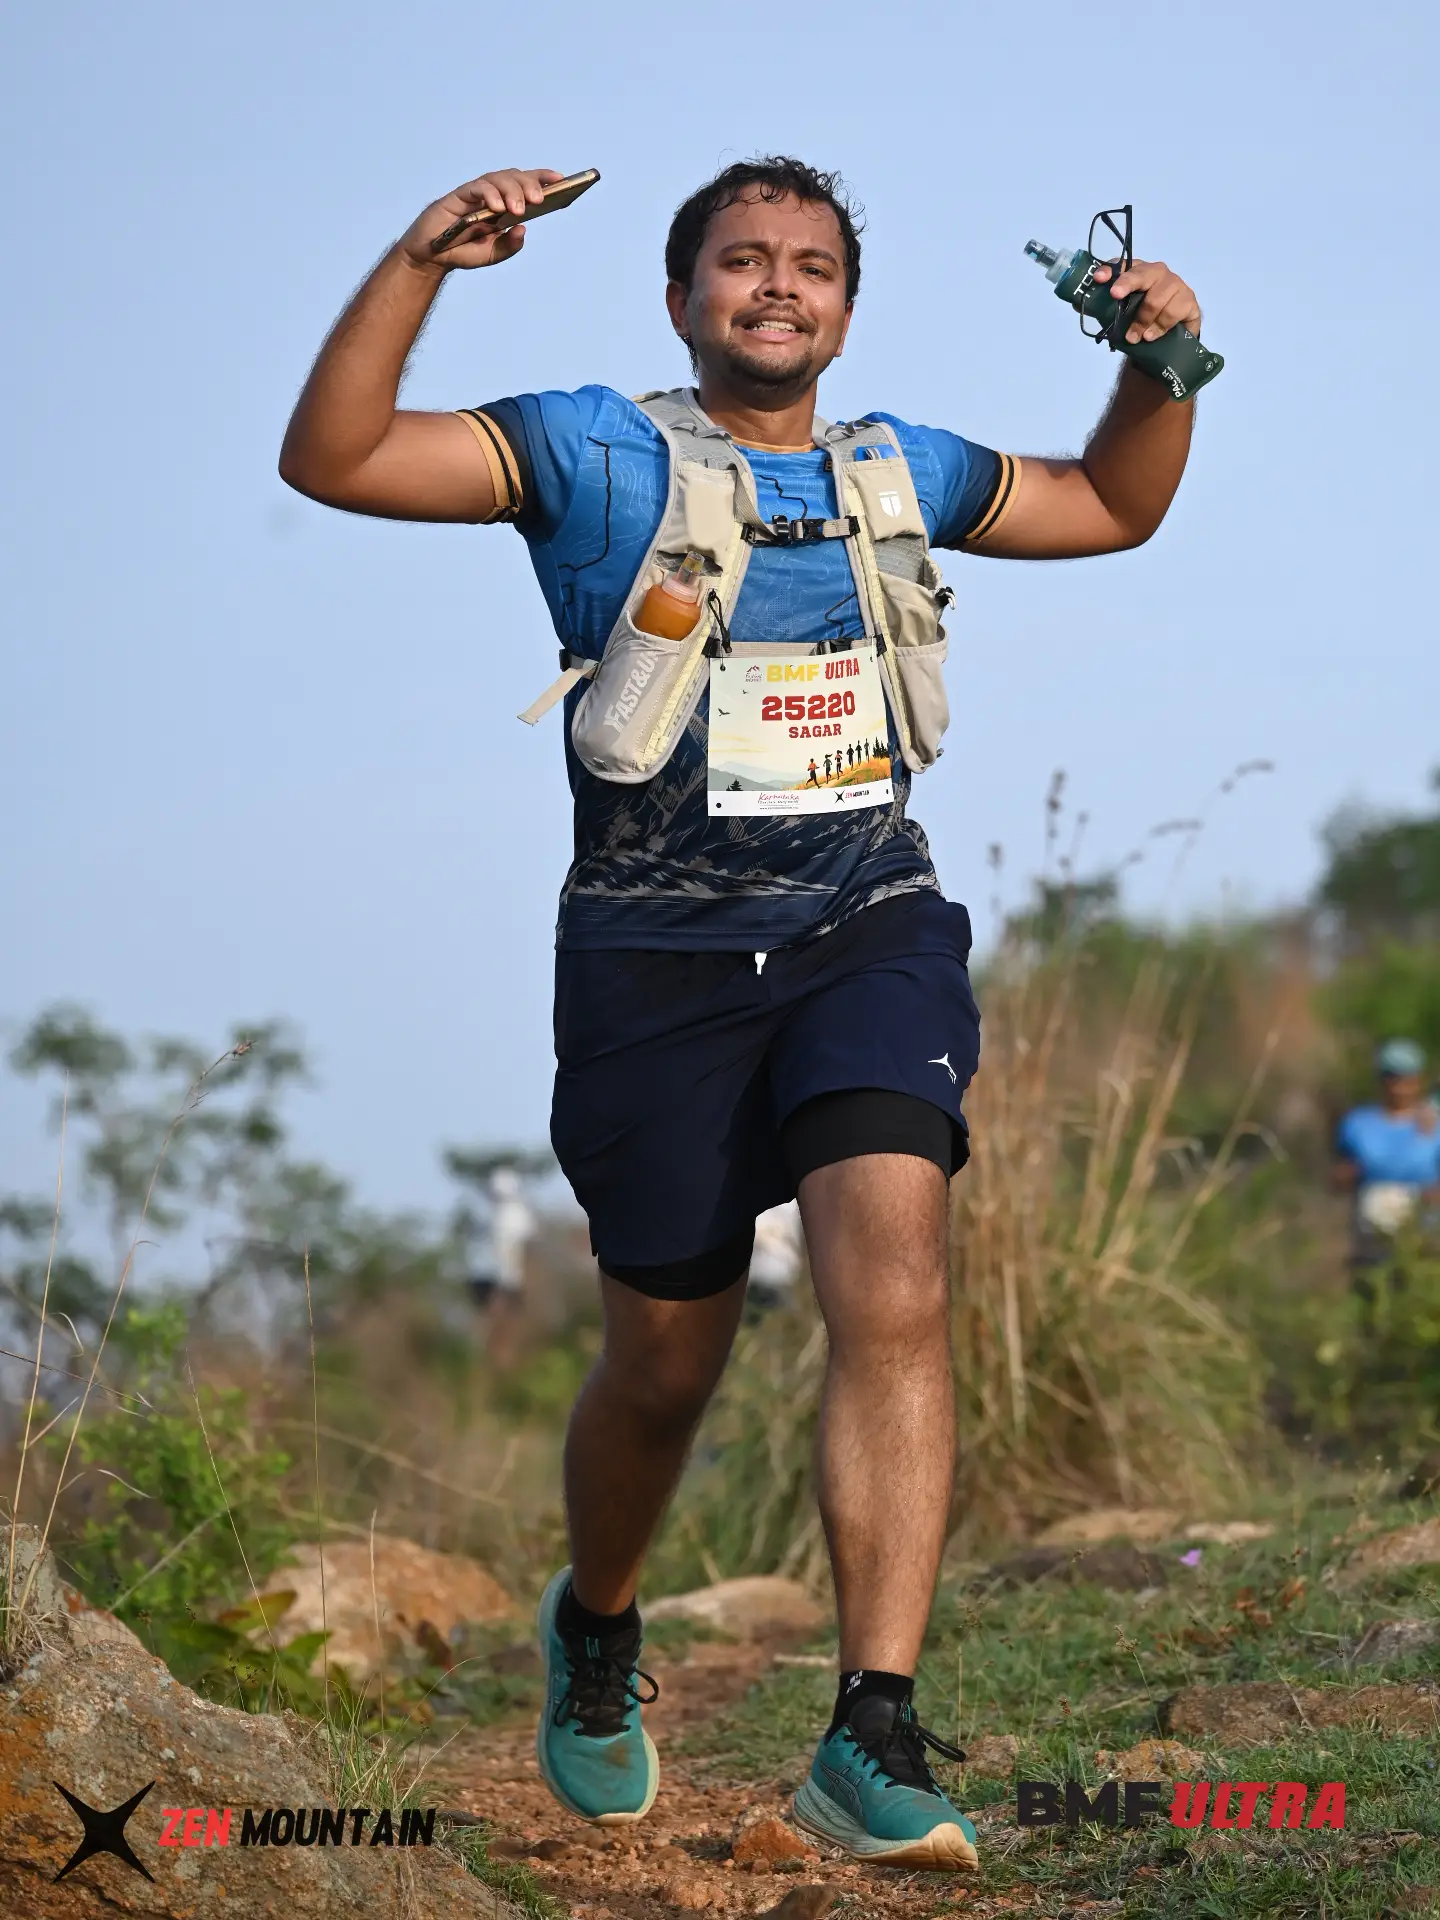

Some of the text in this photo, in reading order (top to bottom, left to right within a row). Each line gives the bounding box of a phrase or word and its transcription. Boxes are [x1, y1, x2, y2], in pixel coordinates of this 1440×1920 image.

[766, 664, 820, 682] BMF
[825, 658, 860, 680] ULTRA
[762, 690, 856, 721] 25220
[789, 723, 842, 739] SAGAR
